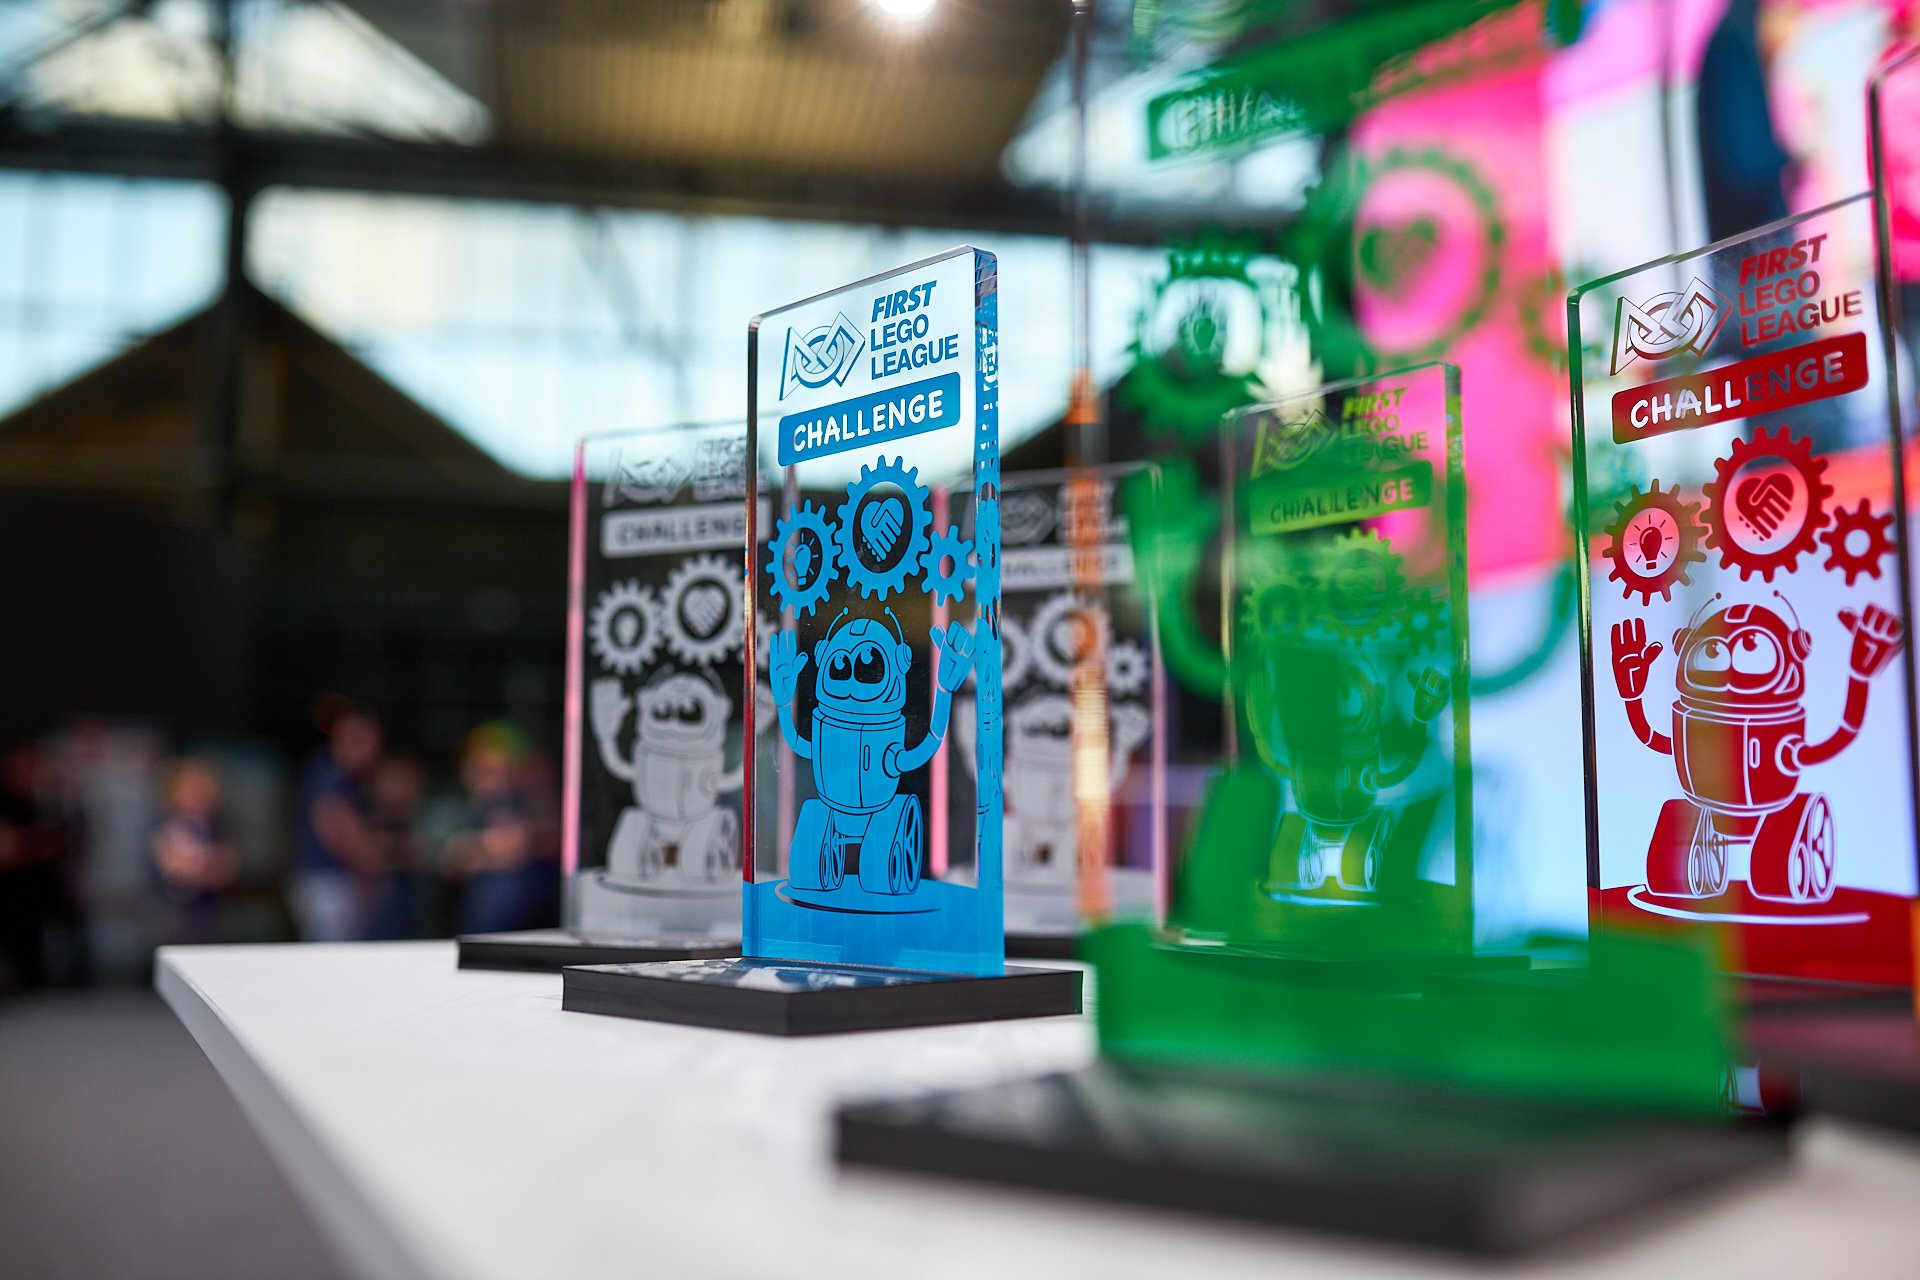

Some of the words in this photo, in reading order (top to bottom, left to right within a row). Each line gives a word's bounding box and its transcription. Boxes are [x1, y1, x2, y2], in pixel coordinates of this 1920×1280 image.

[1739, 233, 1828, 286] FIRST
[871, 280, 937, 323] FIRST
[1738, 270, 1821, 318] LEGO
[871, 313, 929, 352] LEGO
[1740, 290, 1864, 348] LEAGUE
[871, 334, 959, 381] LEAGUE
[1630, 351, 1845, 429] CHALLENGE
[793, 389, 944, 452] CHALLENGE
[615, 517, 746, 546] CHALLENG
